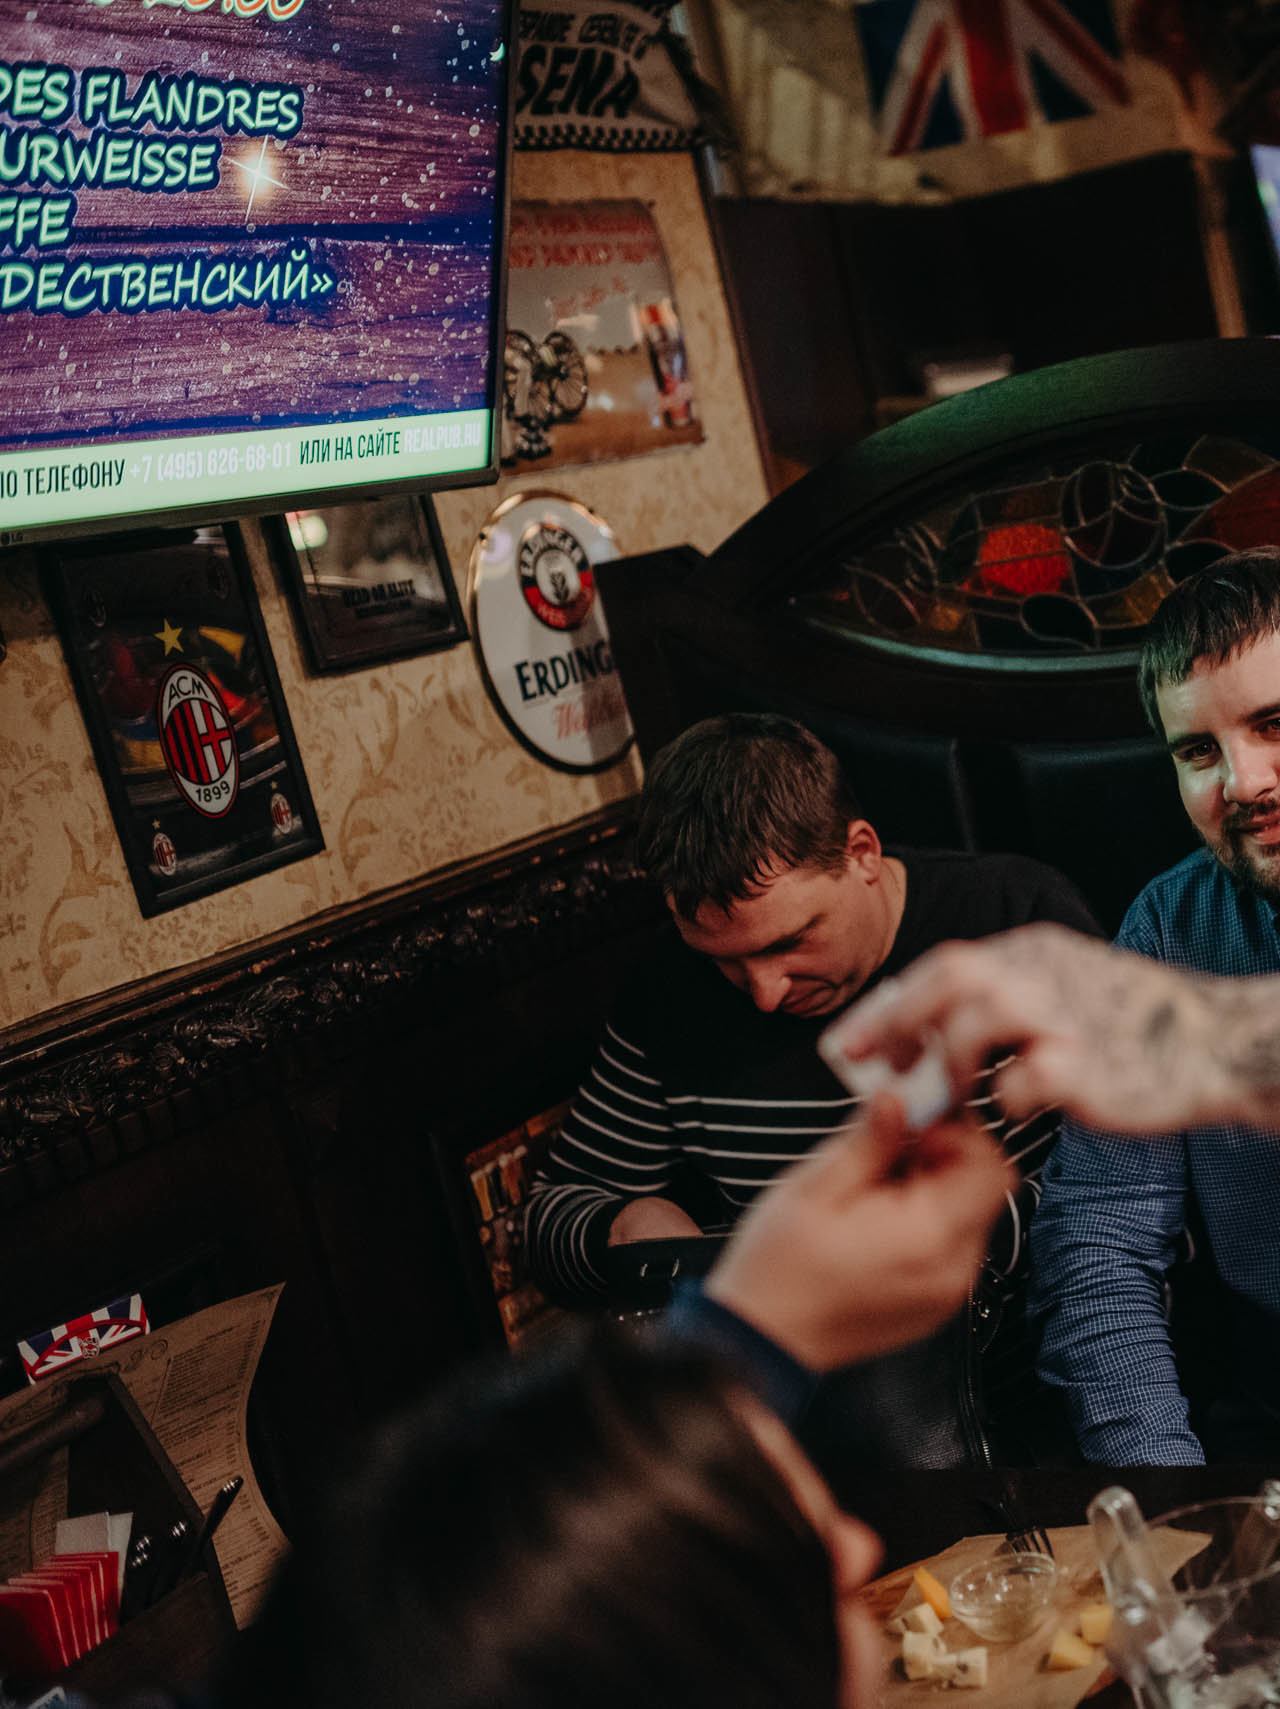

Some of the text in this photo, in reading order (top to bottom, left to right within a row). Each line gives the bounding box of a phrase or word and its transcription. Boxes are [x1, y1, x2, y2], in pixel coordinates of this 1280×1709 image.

[84, 75, 300, 132] FLANDRES
[0, 129, 217, 186] URWEISSE
[23, 458, 126, 497] ТЕЛЕФОНУ
[129, 455, 153, 485] +7
[157, 451, 202, 481] (495)
[206, 441, 292, 478] 626-68-01
[299, 437, 331, 465] ИЛИ
[335, 436, 354, 462] НА
[358, 427, 401, 458] САЙТЕ
[403, 422, 482, 454] REALPUB.RU
[168, 675, 209, 709] ACM
[195, 780, 231, 803] 1899
